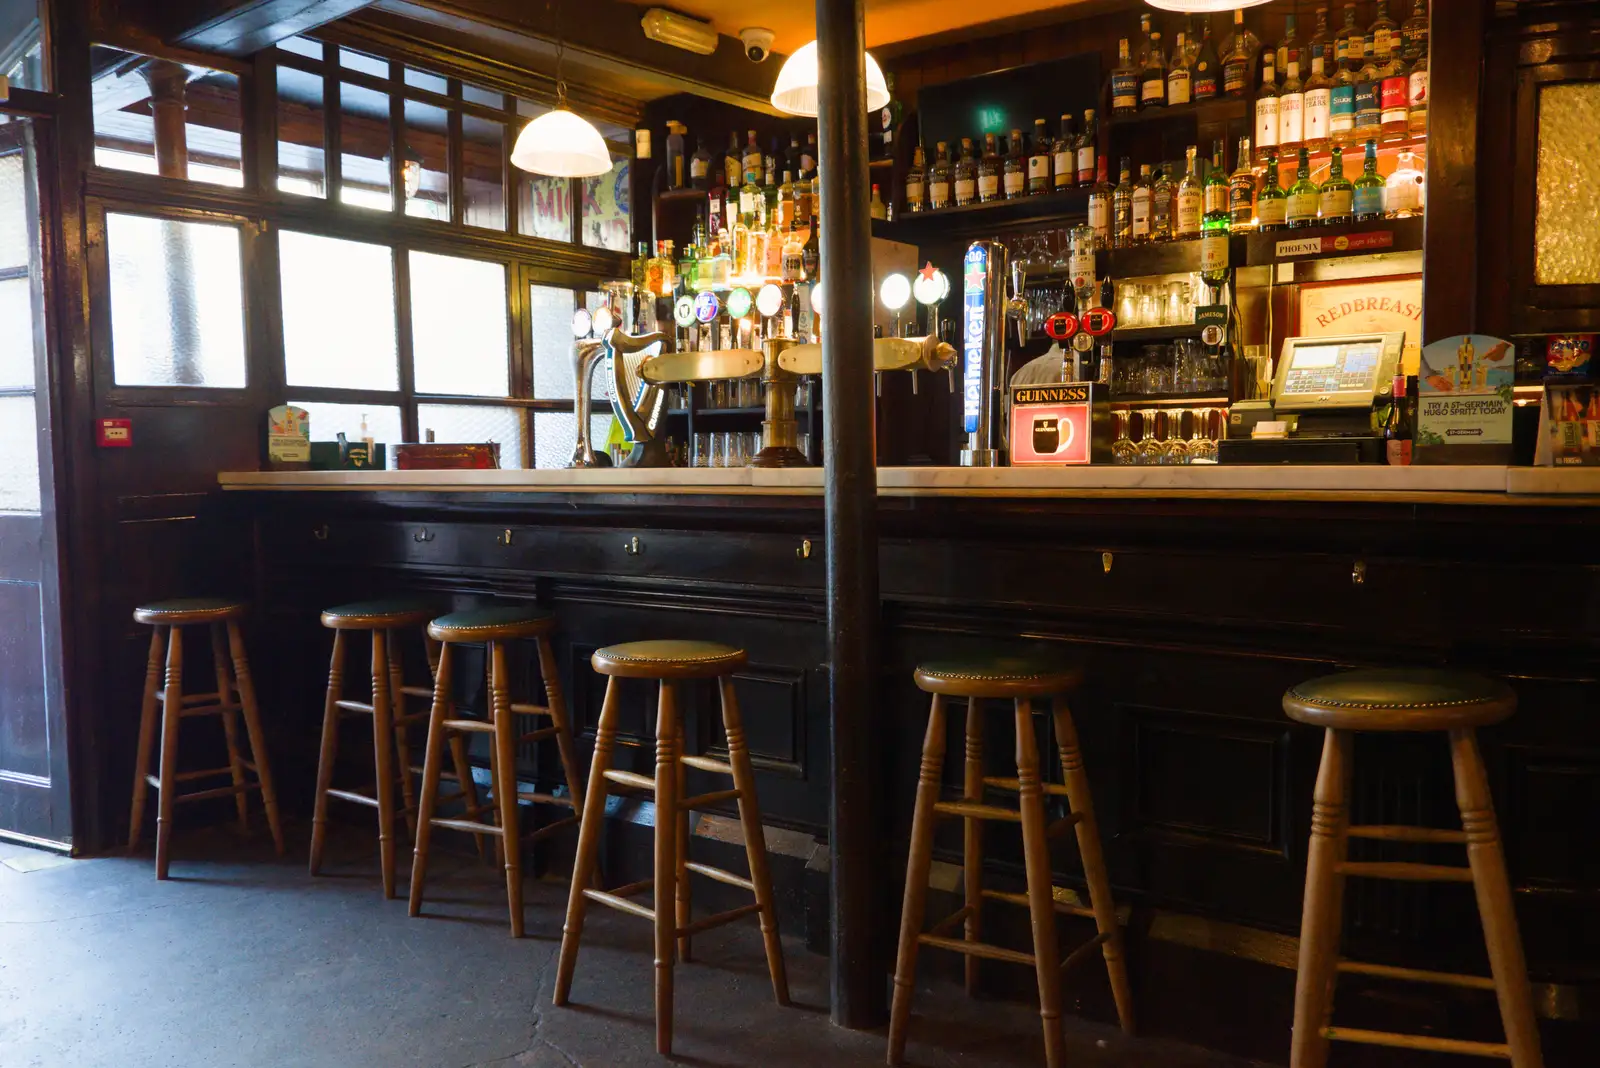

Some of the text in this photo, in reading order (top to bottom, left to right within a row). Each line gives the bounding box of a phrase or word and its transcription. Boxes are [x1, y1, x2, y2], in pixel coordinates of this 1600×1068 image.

[1279, 243, 1319, 254] PHOENIX
[1198, 311, 1225, 320] JAMESON
[964, 304, 985, 416] Heineken
[1016, 388, 1087, 402] GUINNESS
[1428, 400, 1504, 410] TRY A ST-GERMAIN
[1423, 407, 1507, 416] HUGO SPRITZ TODAY
